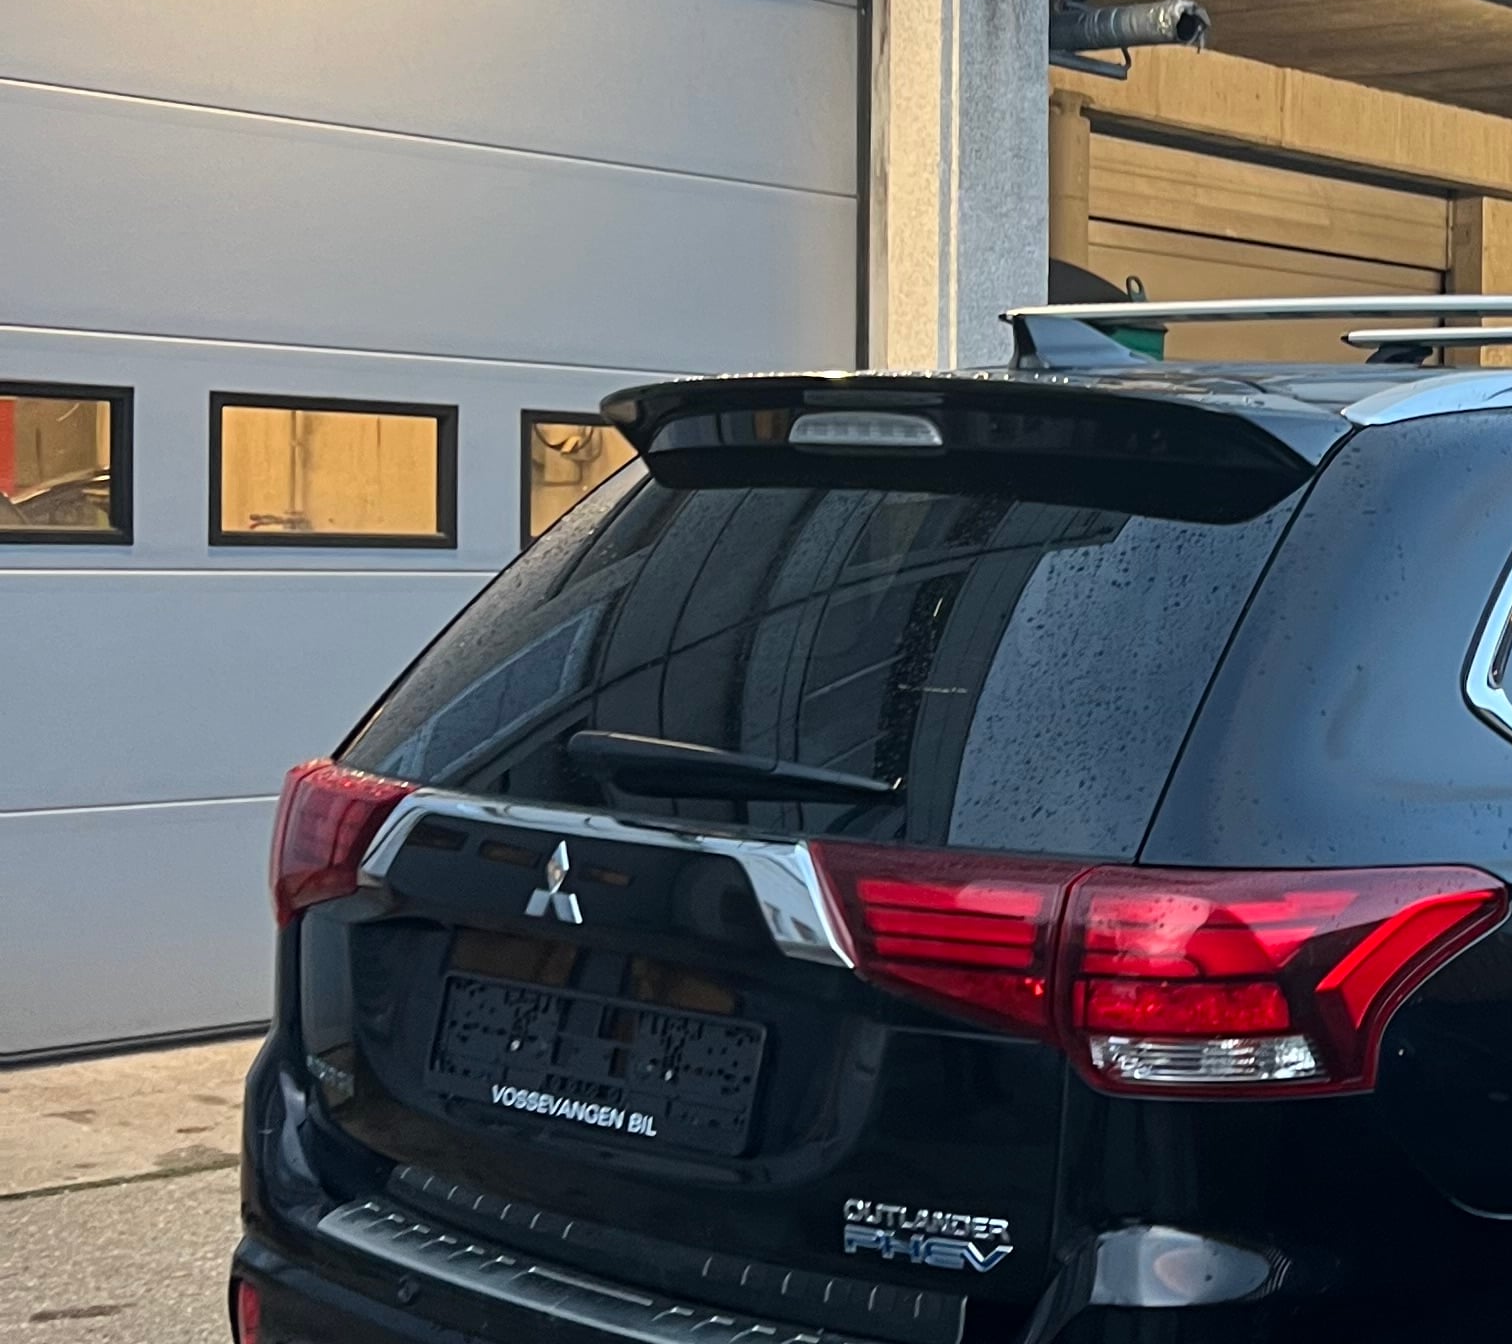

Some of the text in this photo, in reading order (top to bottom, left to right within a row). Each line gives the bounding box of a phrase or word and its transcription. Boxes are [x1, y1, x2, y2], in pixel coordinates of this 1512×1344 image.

[491, 1084, 657, 1137] VOSSEVANGEN BIL
[843, 1198, 1011, 1244] OUTLANDER
[844, 1224, 1013, 1272] PHEV
